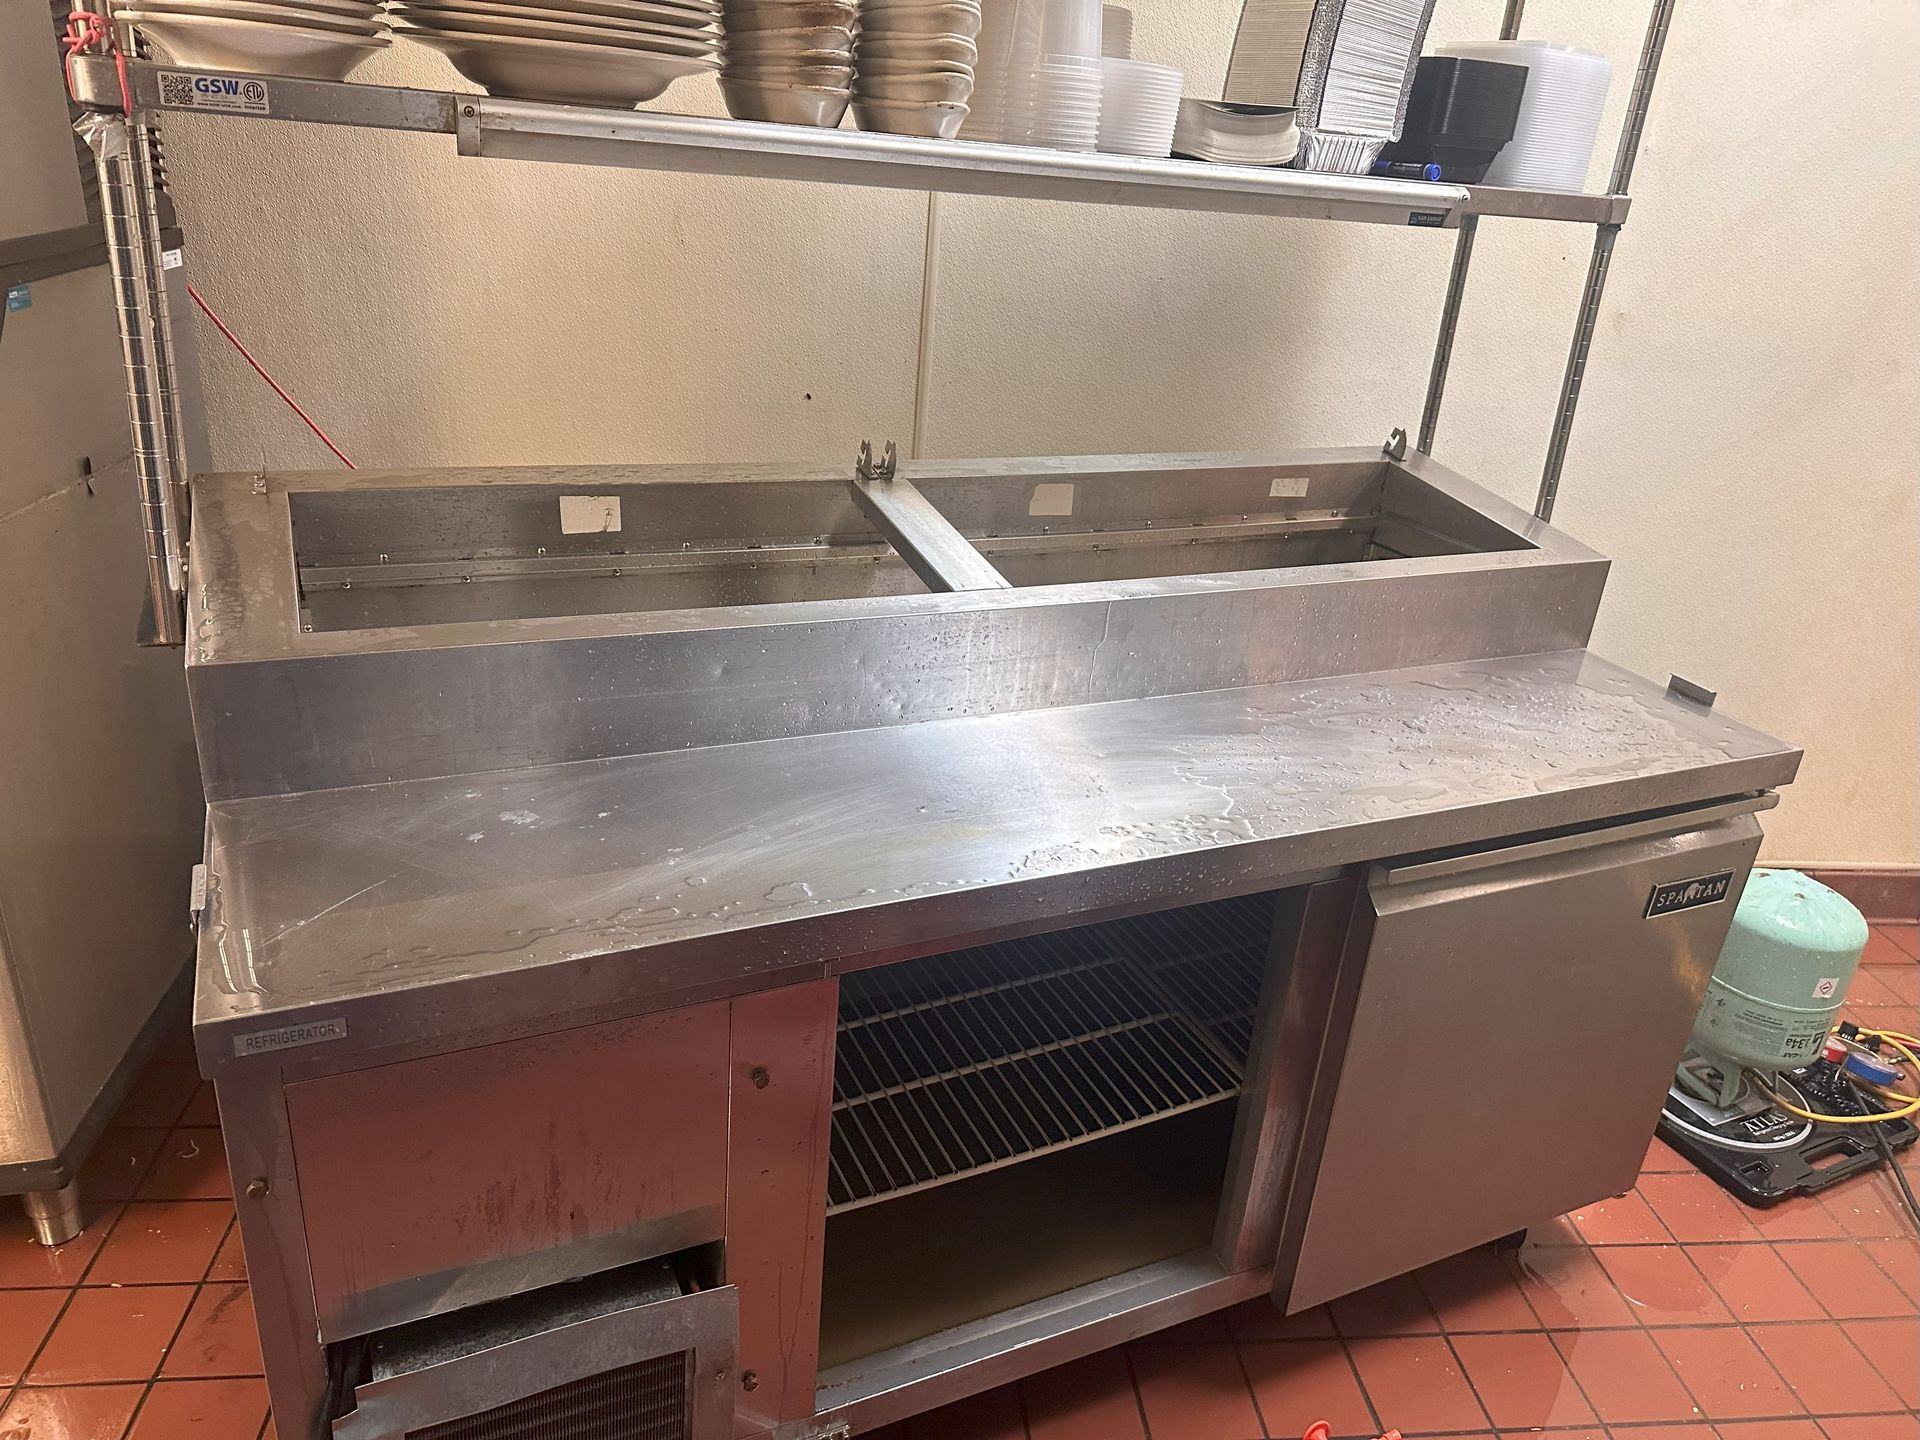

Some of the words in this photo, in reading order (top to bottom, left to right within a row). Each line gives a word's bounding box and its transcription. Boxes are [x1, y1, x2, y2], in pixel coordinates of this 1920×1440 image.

[195, 77, 239, 95] GSW
[1657, 880, 1726, 907] SPARTAN
[246, 1024, 336, 1050] REFRIGERATOR
[1740, 1111, 1788, 1132] ATLAS
